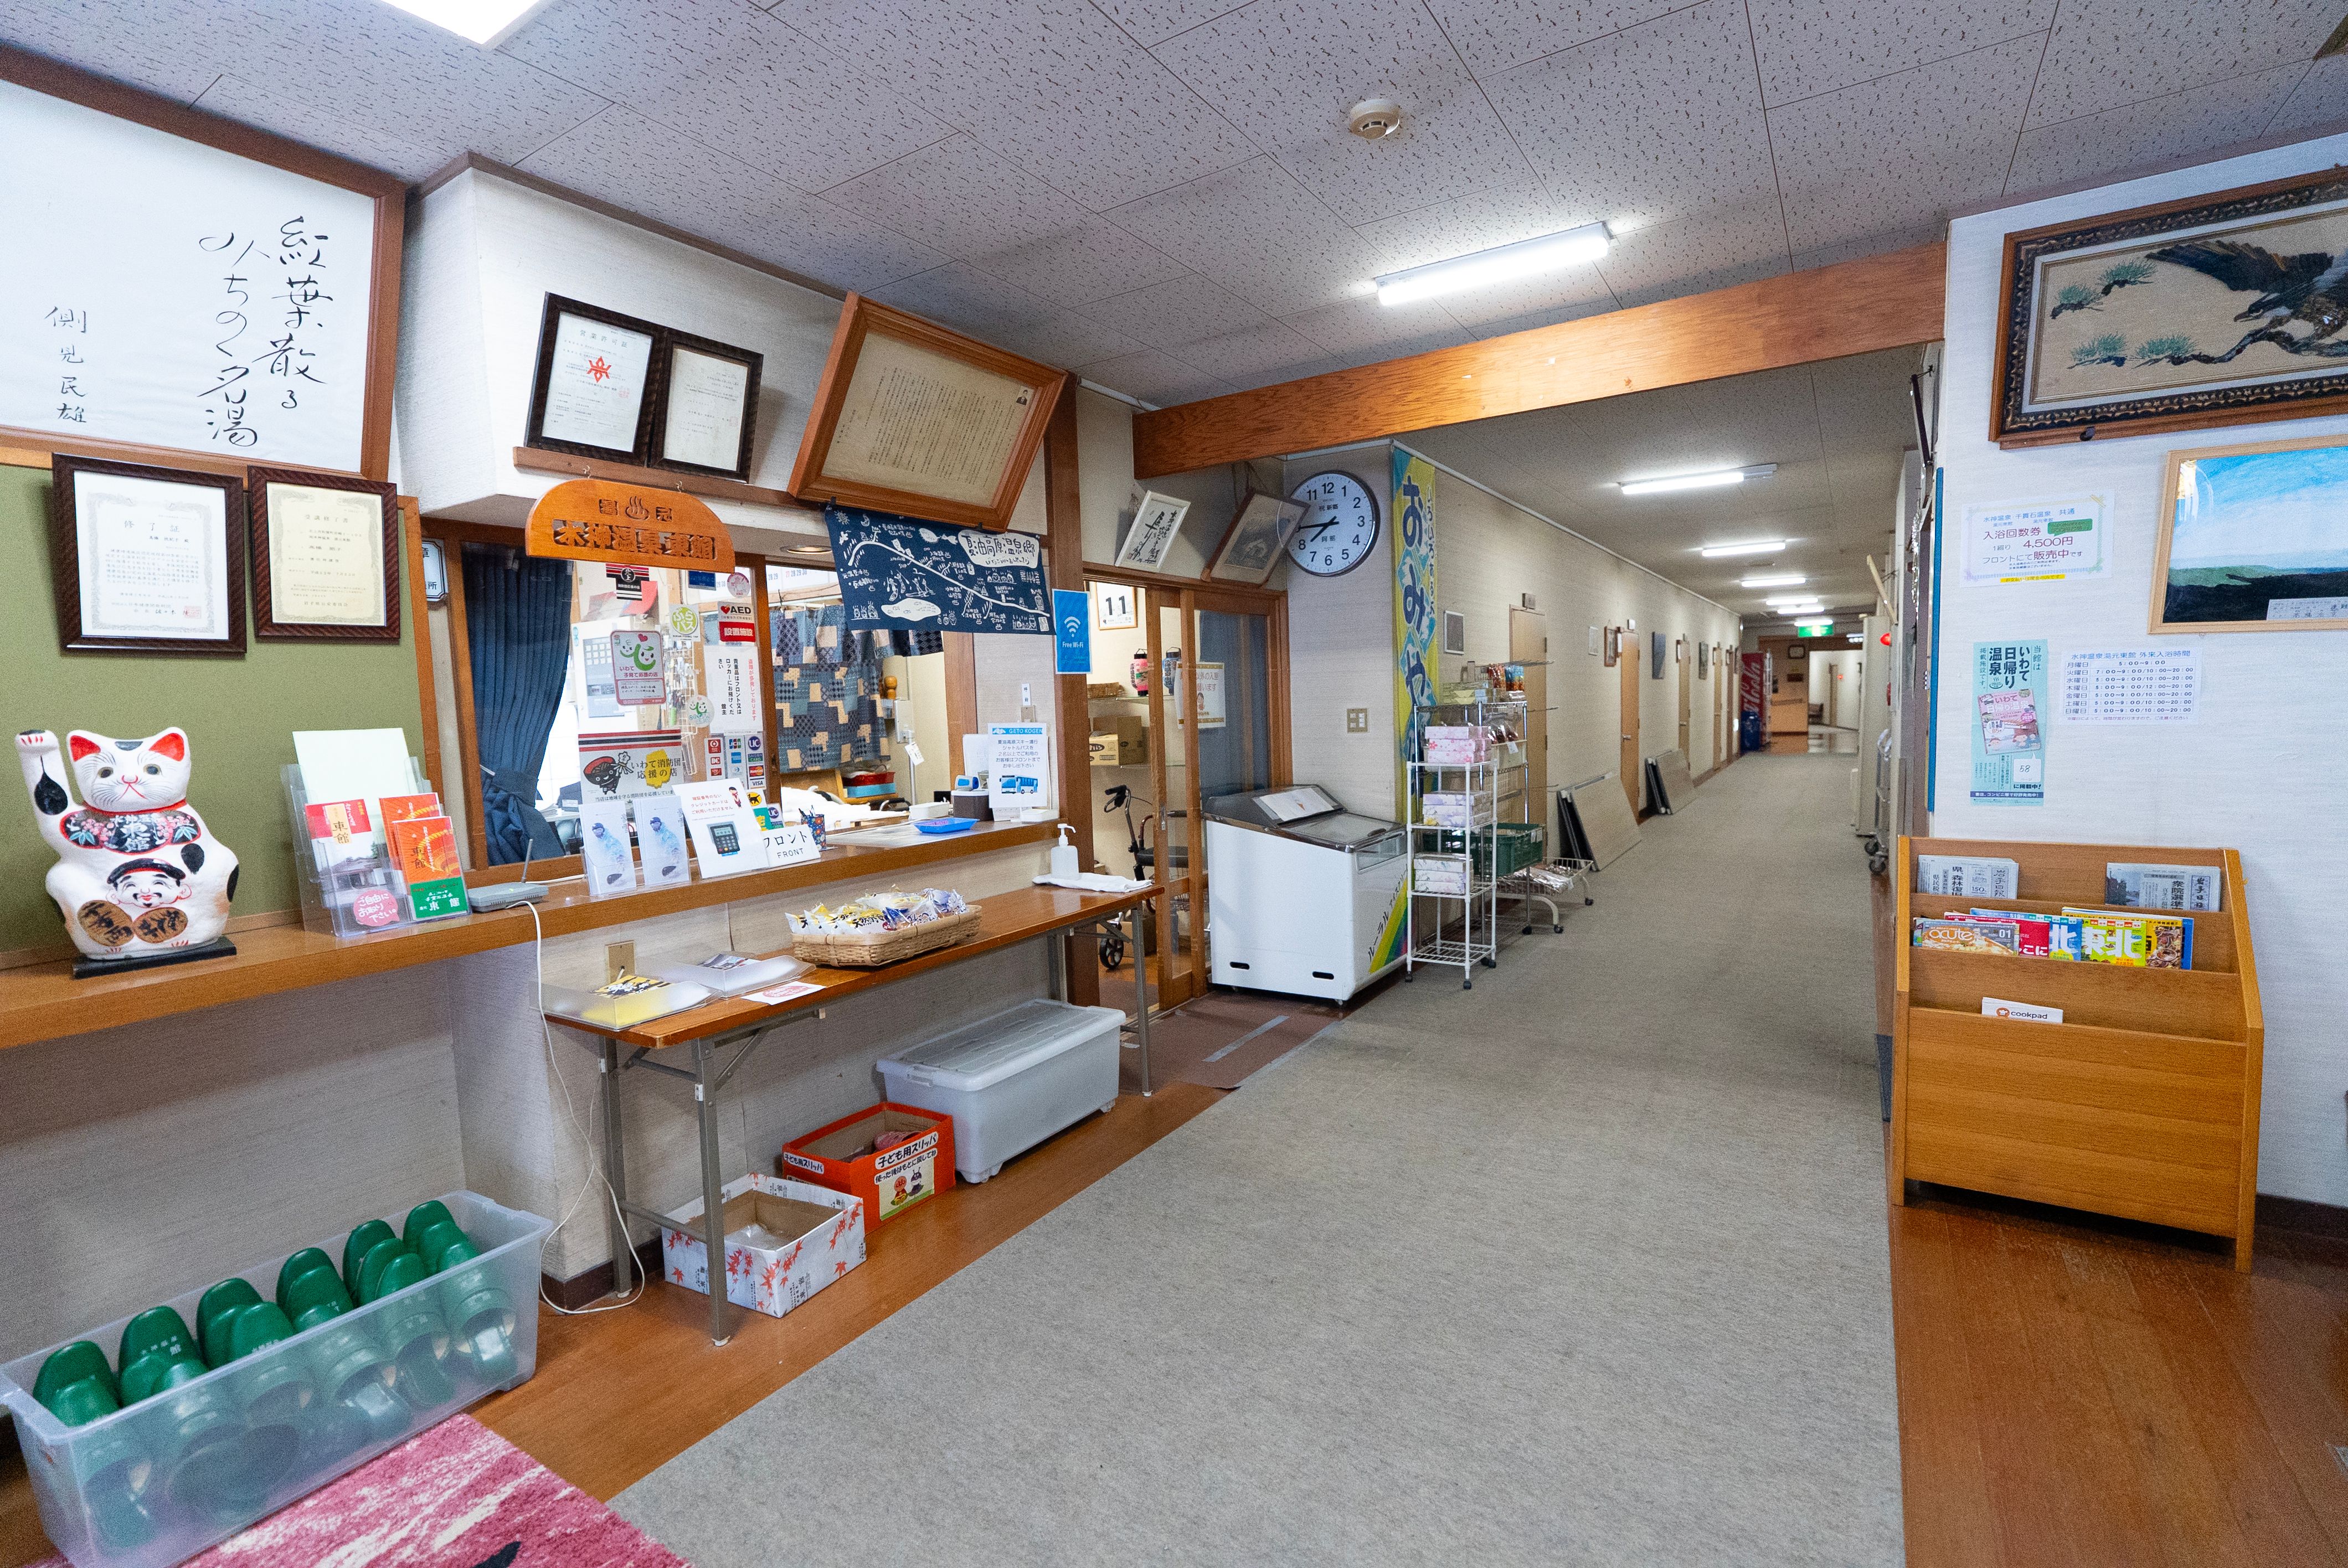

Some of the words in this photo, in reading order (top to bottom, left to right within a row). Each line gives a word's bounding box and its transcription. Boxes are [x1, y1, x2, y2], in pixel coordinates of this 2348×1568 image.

[1321, 482, 1334, 494] 12
[1341, 485, 1346, 497] 1
[1307, 489, 1317, 501] 11
[1353, 497, 1361, 508] 2
[1357, 515, 1364, 527] 3
[1352, 534, 1360, 545] 4
[1983, 527, 2041, 540] 入浴回数券
[961, 534, 1035, 557] 夏油高原温泉郷
[1299, 539, 1306, 550] 8
[2023, 536, 2073, 549] 4,500円
[1310, 551, 1317, 562] 7
[1325, 555, 1332, 566] 6
[1341, 549, 1349, 560] 5
[1983, 549, 2083, 564] フロントにて販売中です
[730, 606, 751, 615] AED
[1989, 647, 2002, 675] 温泉
[2033, 645, 2042, 670] 当館は
[2071, 652, 2137, 660] 水神温泉湯元東館
[718, 658, 724, 669] さい
[2004, 647, 2017, 689] 日帰り
[2019, 646, 2030, 682] いわて
[726, 658, 734, 715] ロッカーにお預けくだ
[733, 658, 742, 715] 貴重品はフロント又は
[1995, 695, 2017, 703] いわて
[749, 739, 760, 747] UC
[631, 757, 681, 769] いわて消防団
[2020, 765, 2031, 773] 58
[637, 768, 677, 780] 応援の店
[692, 806, 733, 814] ご利用いただけません
[120, 822, 151, 852] 東館
[332, 821, 349, 844] 東館
[764, 831, 807, 848] フロント
[777, 848, 804, 858] FRONT
[357, 893, 390, 907] ご自由に
[2171, 880, 2185, 910] 衆院選準
[358, 903, 384, 917] お取り
[369, 909, 397, 923] 下さい。
[1929, 928, 1974, 941] acute
[1999, 929, 2011, 938] 01
[2010, 1009, 2048, 1020] cookpad
[878, 1133, 938, 1168] 子ども用スリッパ
[784, 1153, 823, 1173] 子ども用スリッパ
[875, 1148, 937, 1183] 使った後はもとに戻してね
